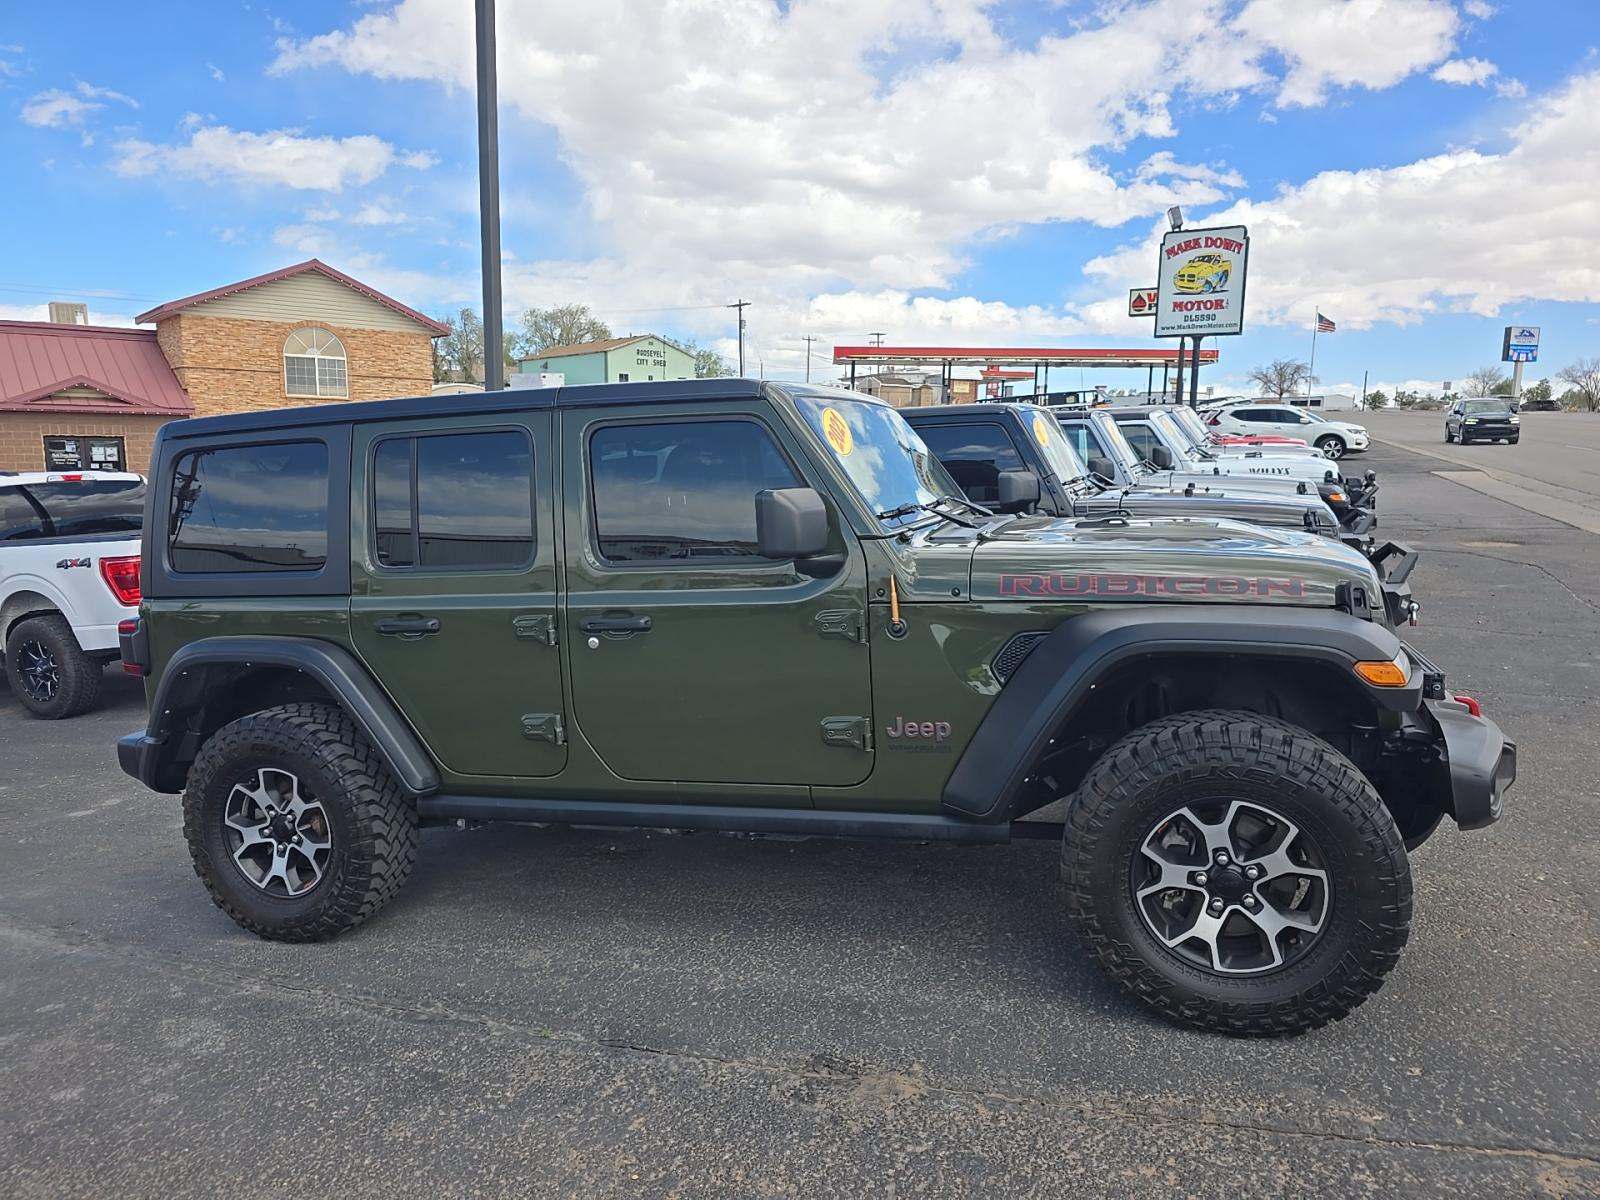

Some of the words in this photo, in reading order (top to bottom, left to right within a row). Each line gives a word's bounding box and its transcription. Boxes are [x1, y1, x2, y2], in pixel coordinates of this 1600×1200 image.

[1165, 238, 1202, 259] MARK
[1204, 237, 1244, 254] DOWN
[1172, 299, 1224, 312] MOTOR
[1184, 314, 1216, 322] DL5590
[1161, 323, 1238, 331] www.MarkDownMotor.com
[999, 573, 1305, 597] RUBICON
[886, 716, 952, 742] Jeep
